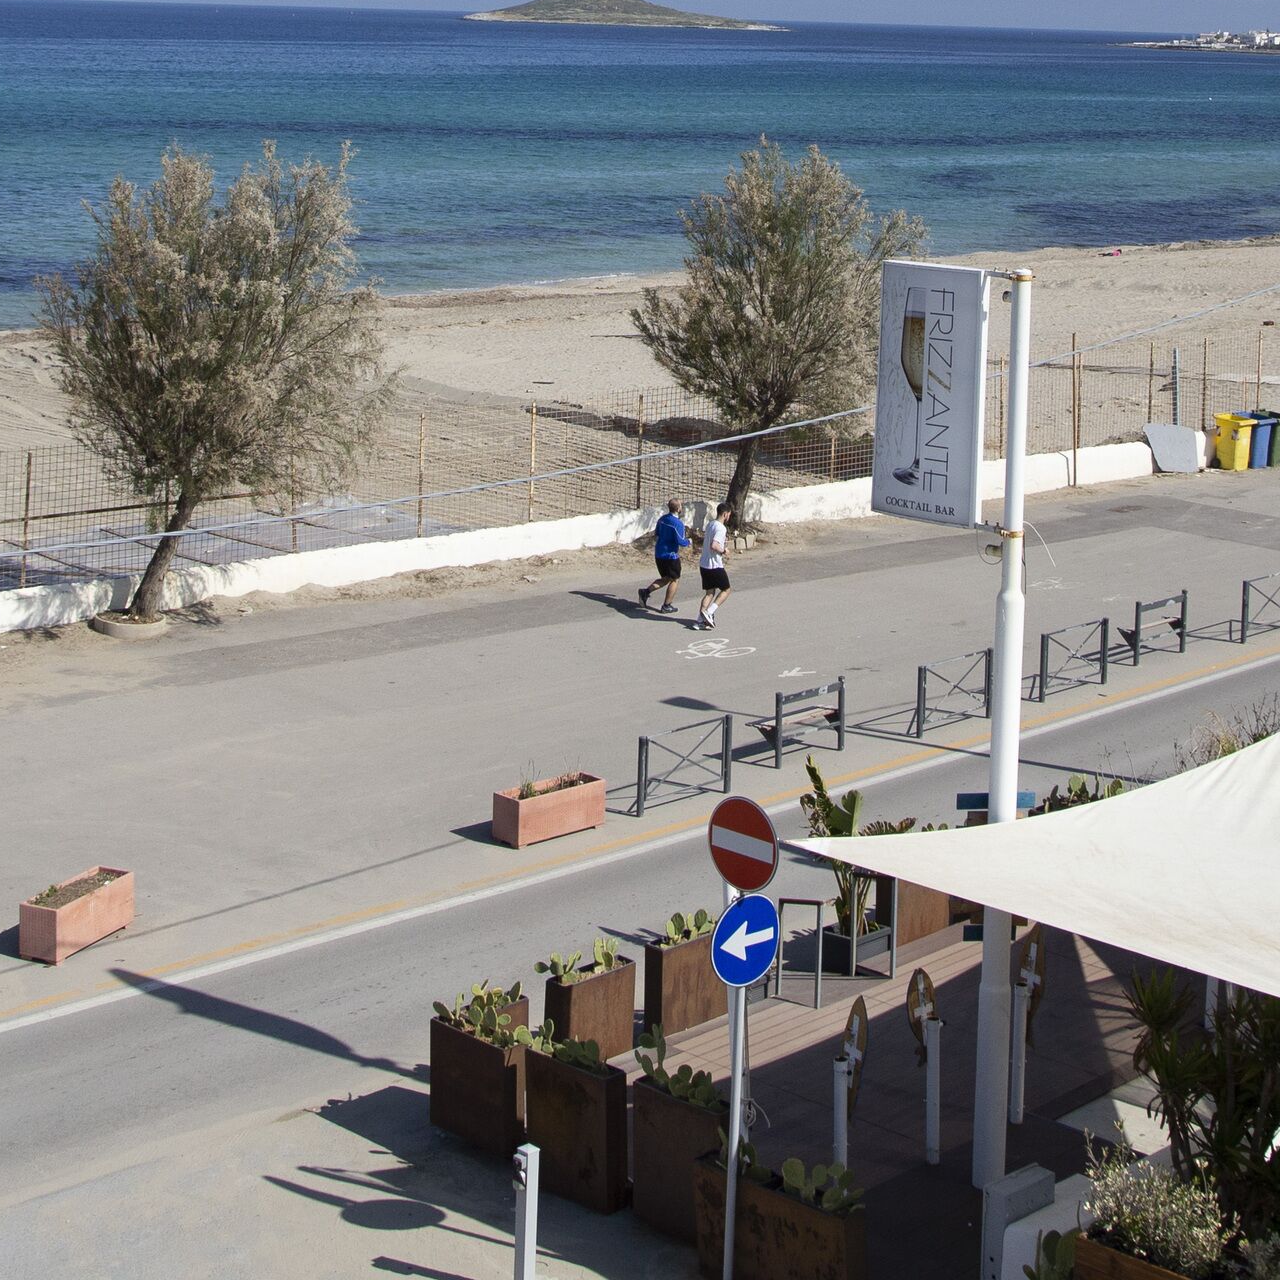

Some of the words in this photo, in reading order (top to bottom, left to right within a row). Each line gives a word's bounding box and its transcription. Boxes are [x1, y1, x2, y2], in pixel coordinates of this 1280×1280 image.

[922, 287, 955, 495] FRIZZANTE
[885, 495, 932, 513] COCKTAIL
[934, 501, 956, 517] BAR
